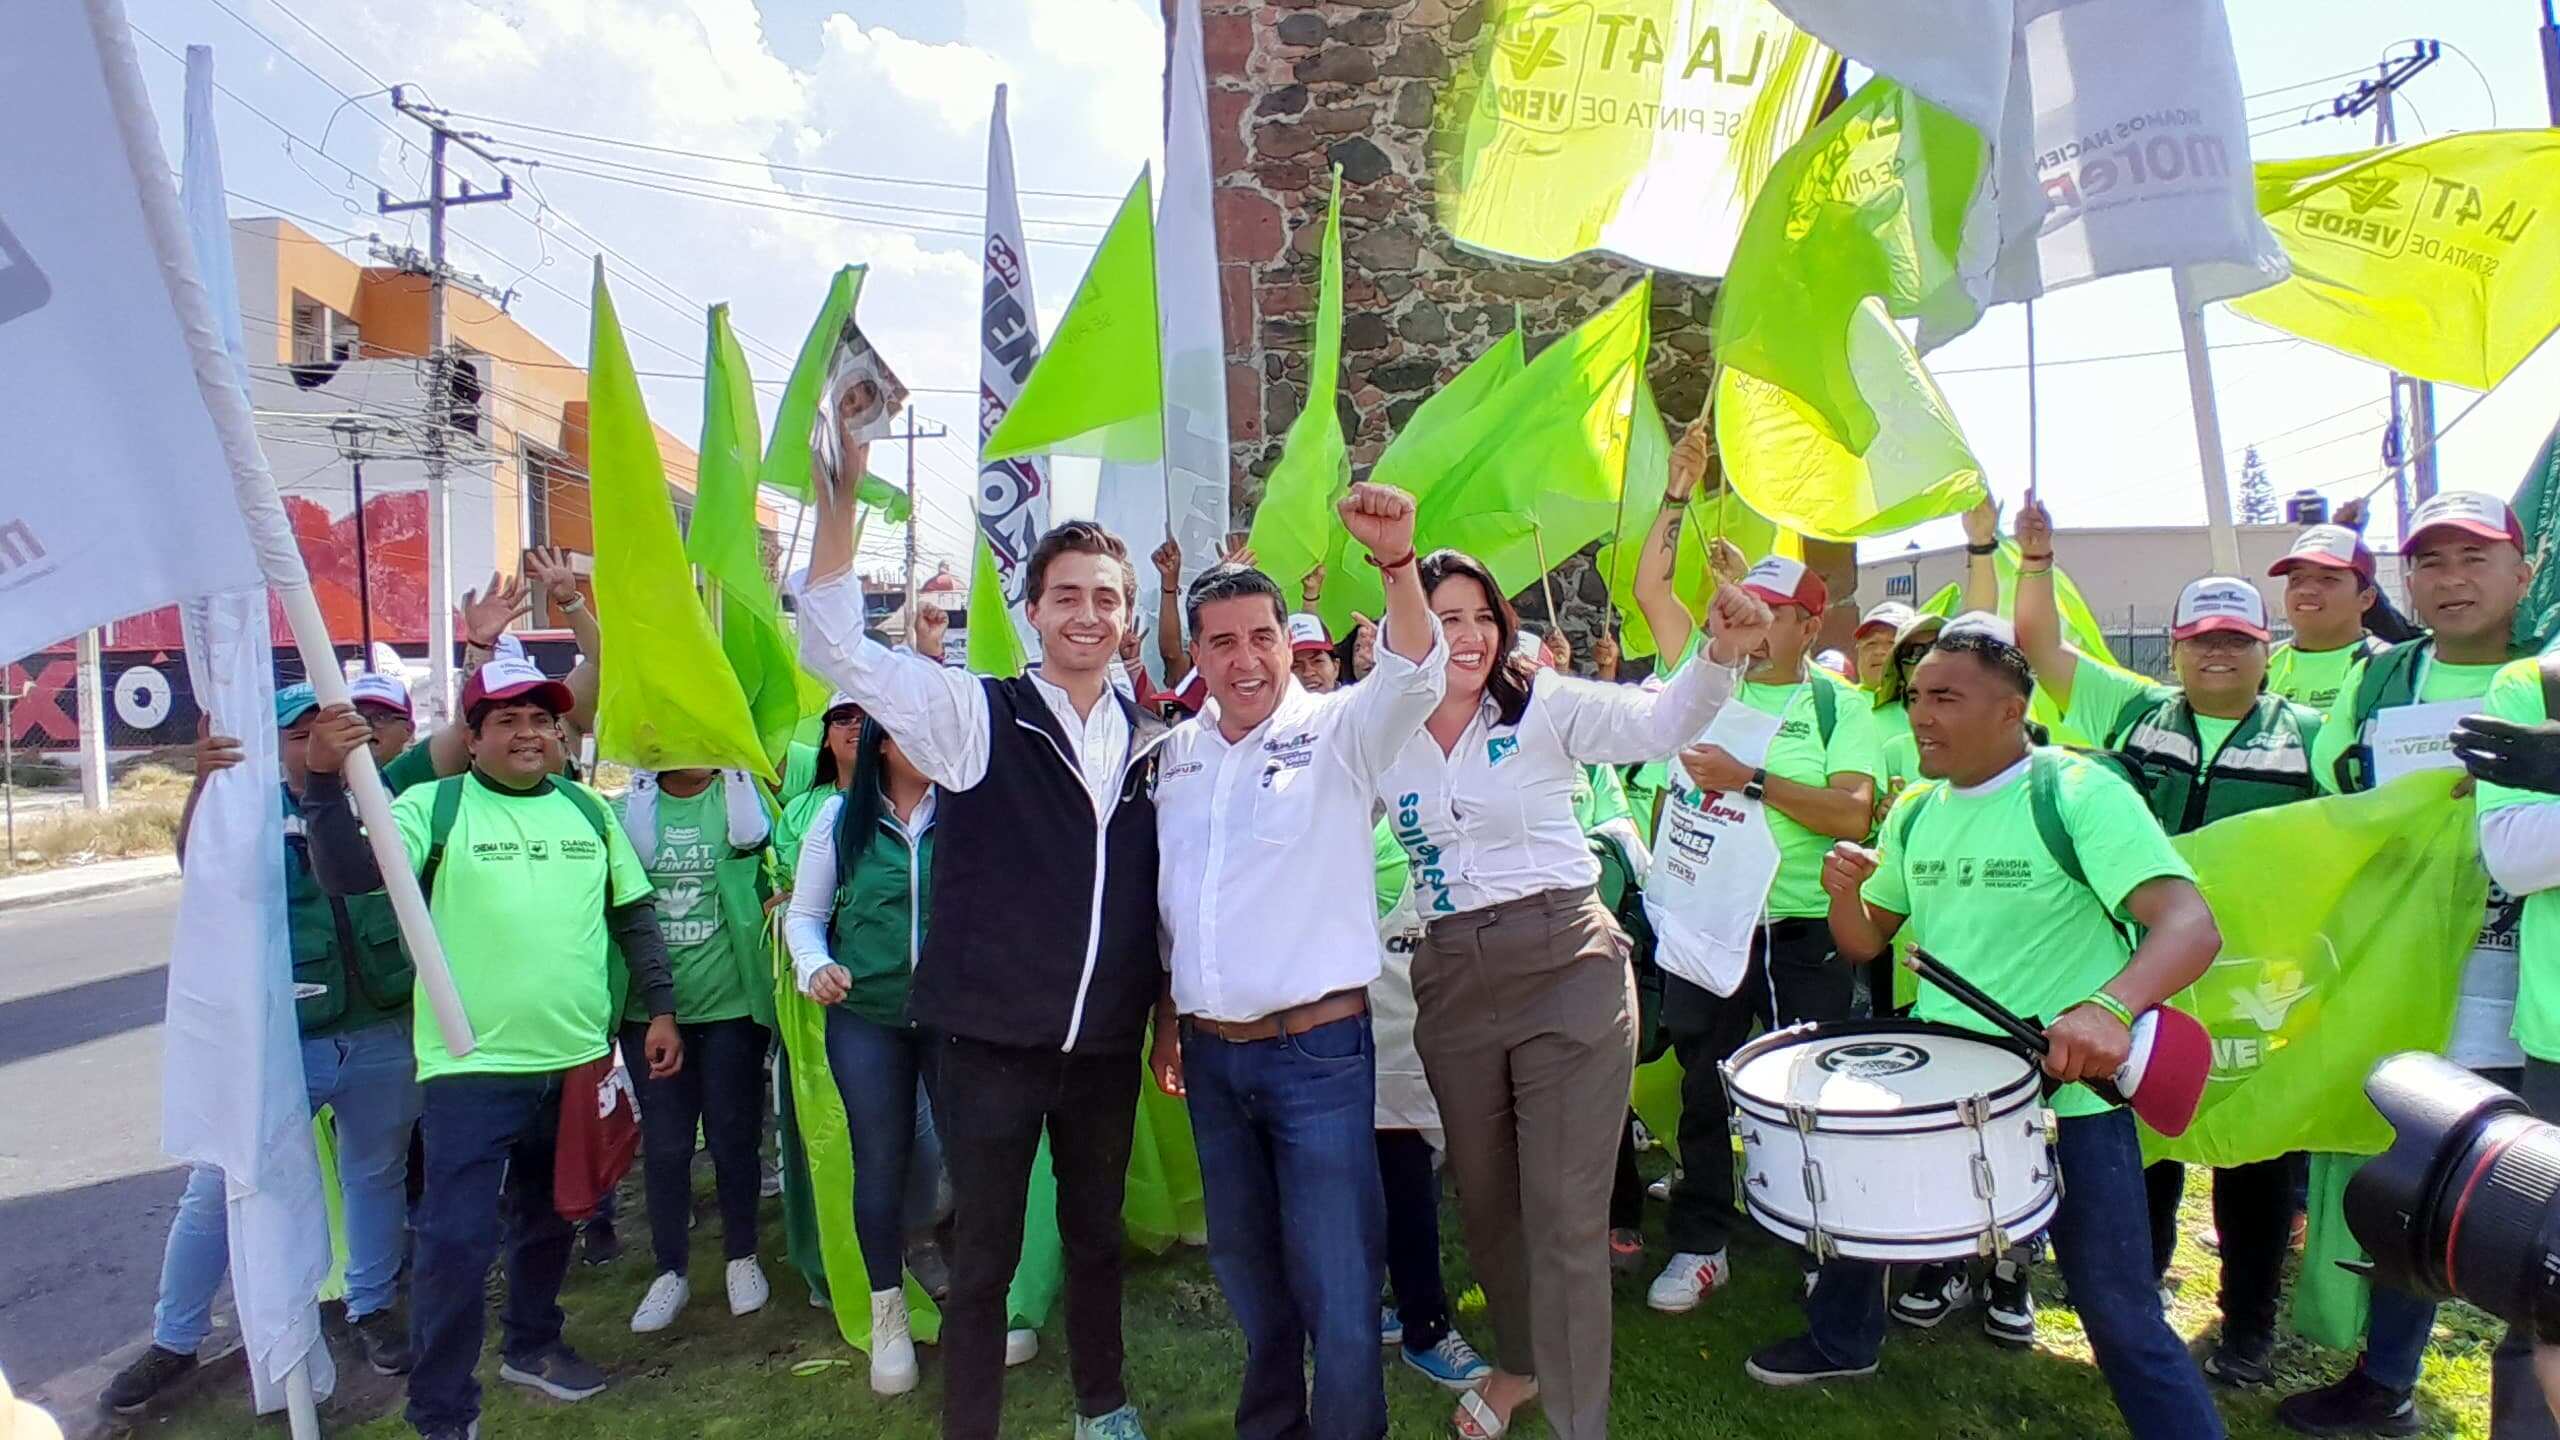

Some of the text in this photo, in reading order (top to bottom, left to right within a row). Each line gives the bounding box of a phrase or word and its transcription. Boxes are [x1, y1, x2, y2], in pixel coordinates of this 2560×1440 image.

[987, 238, 1021, 287] Con
[655, 844, 714, 861] A 4T
[657, 859, 715, 872] PINTA D
[659, 921, 715, 941] ERDE
